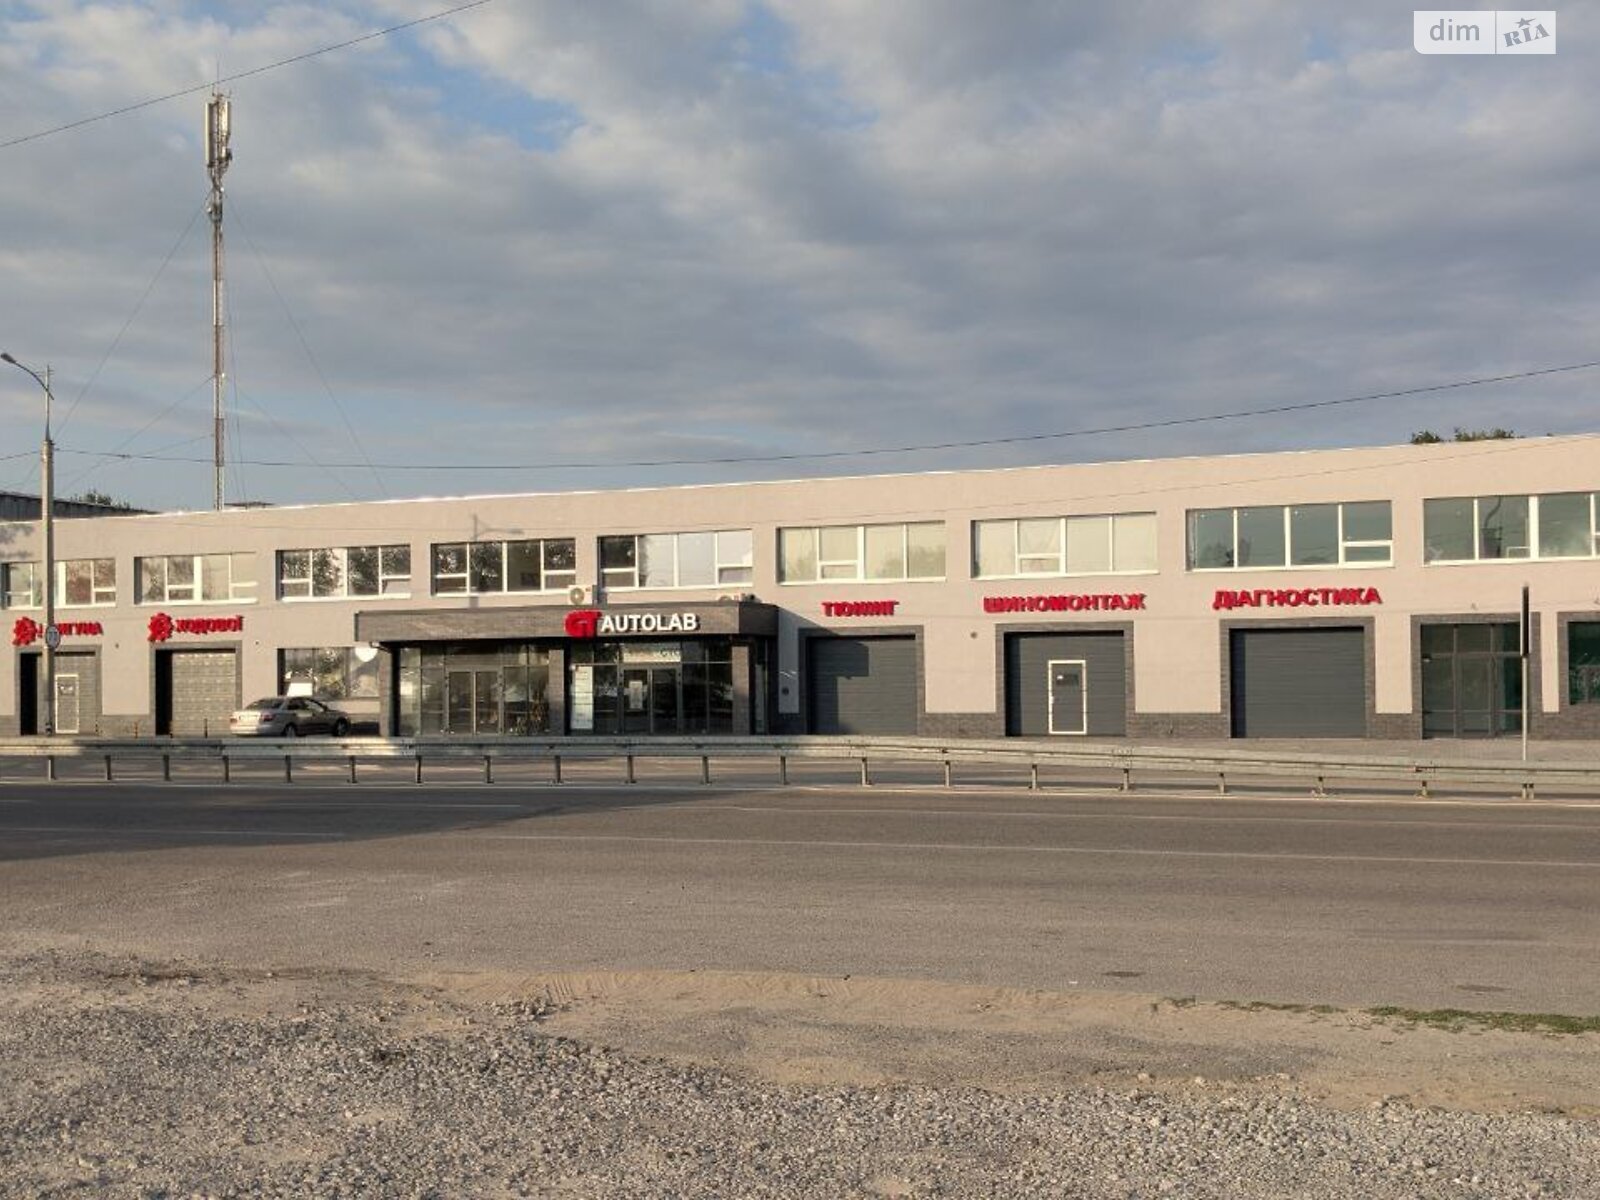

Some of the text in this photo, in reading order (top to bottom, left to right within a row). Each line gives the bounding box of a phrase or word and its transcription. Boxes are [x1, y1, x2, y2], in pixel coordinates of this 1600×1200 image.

[983, 593, 1147, 613] ШИНОМОНТАЖ
[1213, 587, 1383, 610] ДІАГНОСТИКА
[564, 608, 699, 638] GT AUTOLAB
